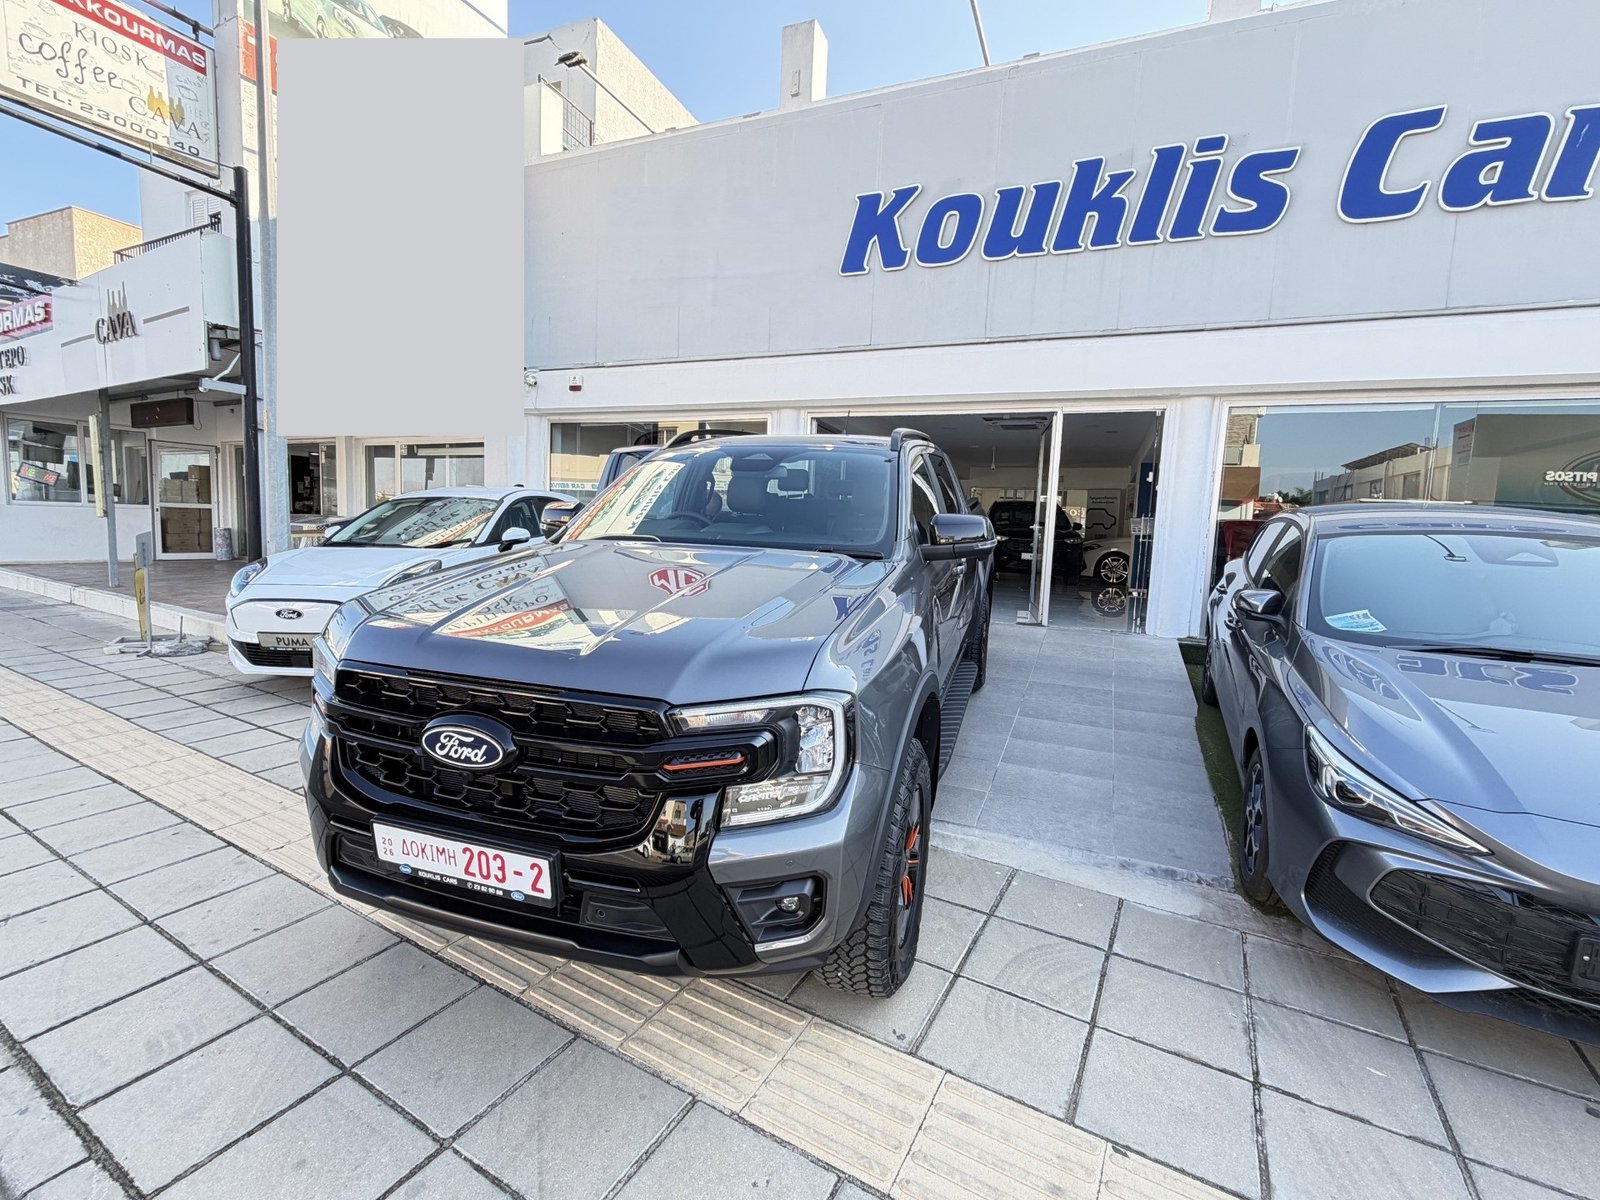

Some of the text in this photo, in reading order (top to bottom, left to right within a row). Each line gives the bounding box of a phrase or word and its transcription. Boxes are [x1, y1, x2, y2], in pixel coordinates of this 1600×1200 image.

[72, 20, 151, 71] KIOSK
[128, 95, 204, 141] CAVA
[839, 133, 1301, 277] Kouklis
[95, 310, 137, 344] CAVA
[276, 636, 310, 647] PUMA
[435, 731, 488, 763] Ford
[381, 836, 393, 847] 20
[383, 847, 394, 857] 26
[418, 870, 458, 885] KOUKLIS CARS
